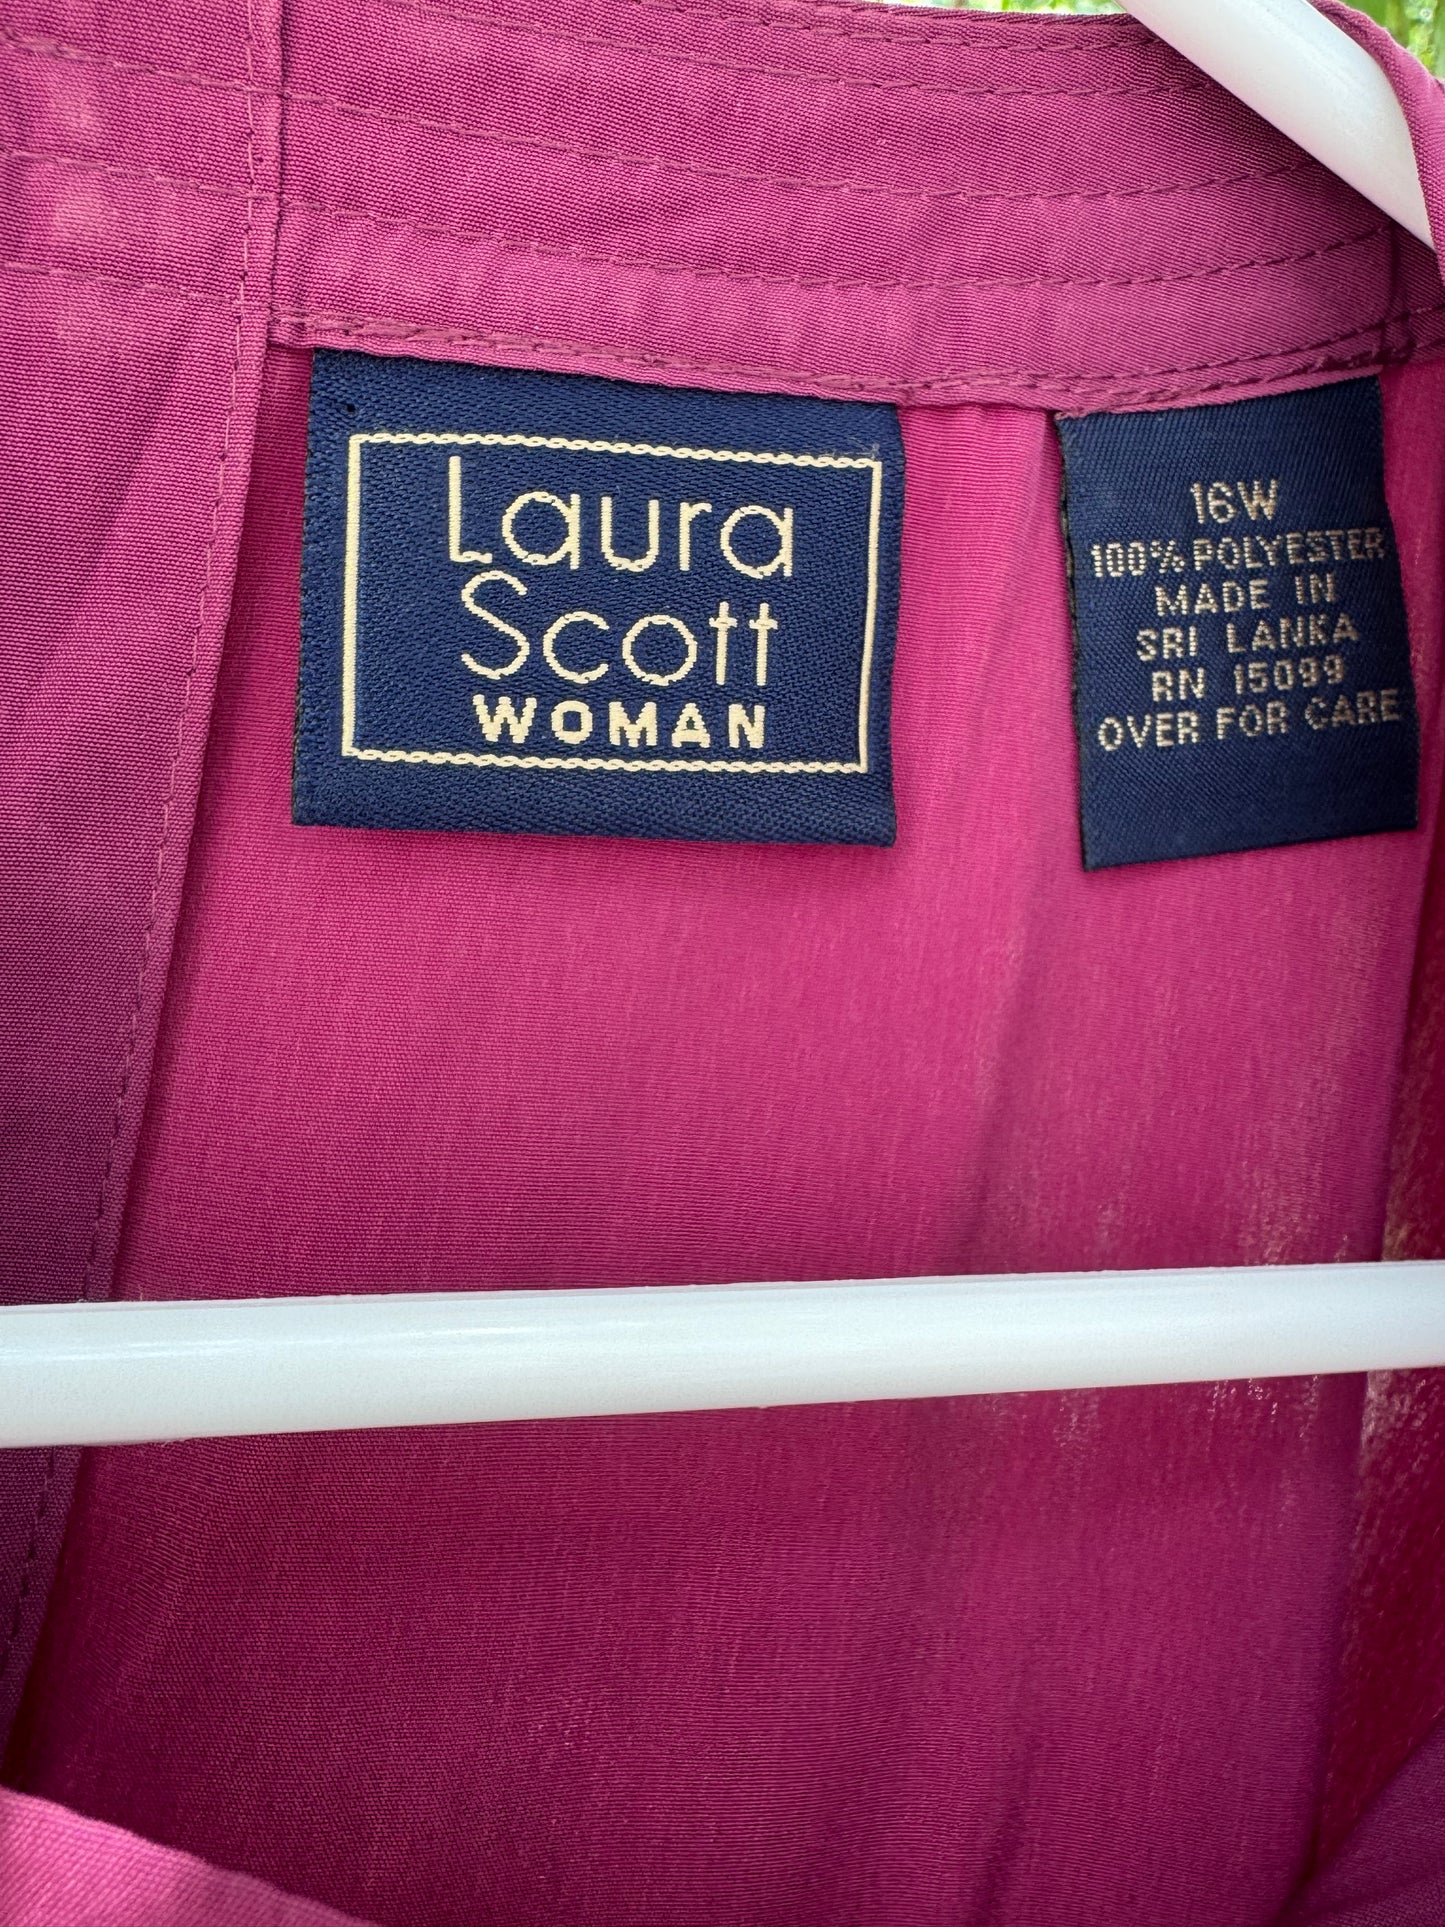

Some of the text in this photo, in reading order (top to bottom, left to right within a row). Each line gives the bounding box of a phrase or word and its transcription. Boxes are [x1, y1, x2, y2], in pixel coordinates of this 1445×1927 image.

[448, 455, 794, 579] Laura
[1190, 479, 1279, 523] 16W
[1091, 527, 1385, 577] 100% POLYESTER
[1155, 573, 1336, 616] MADE IN
[461, 570, 778, 686] Scott
[1136, 613, 1359, 661] SRI LANKA
[1152, 654, 1344, 701] RN 15099
[472, 695, 765, 749] WOMAN
[1098, 689, 1400, 751] OVER FOR CARE
